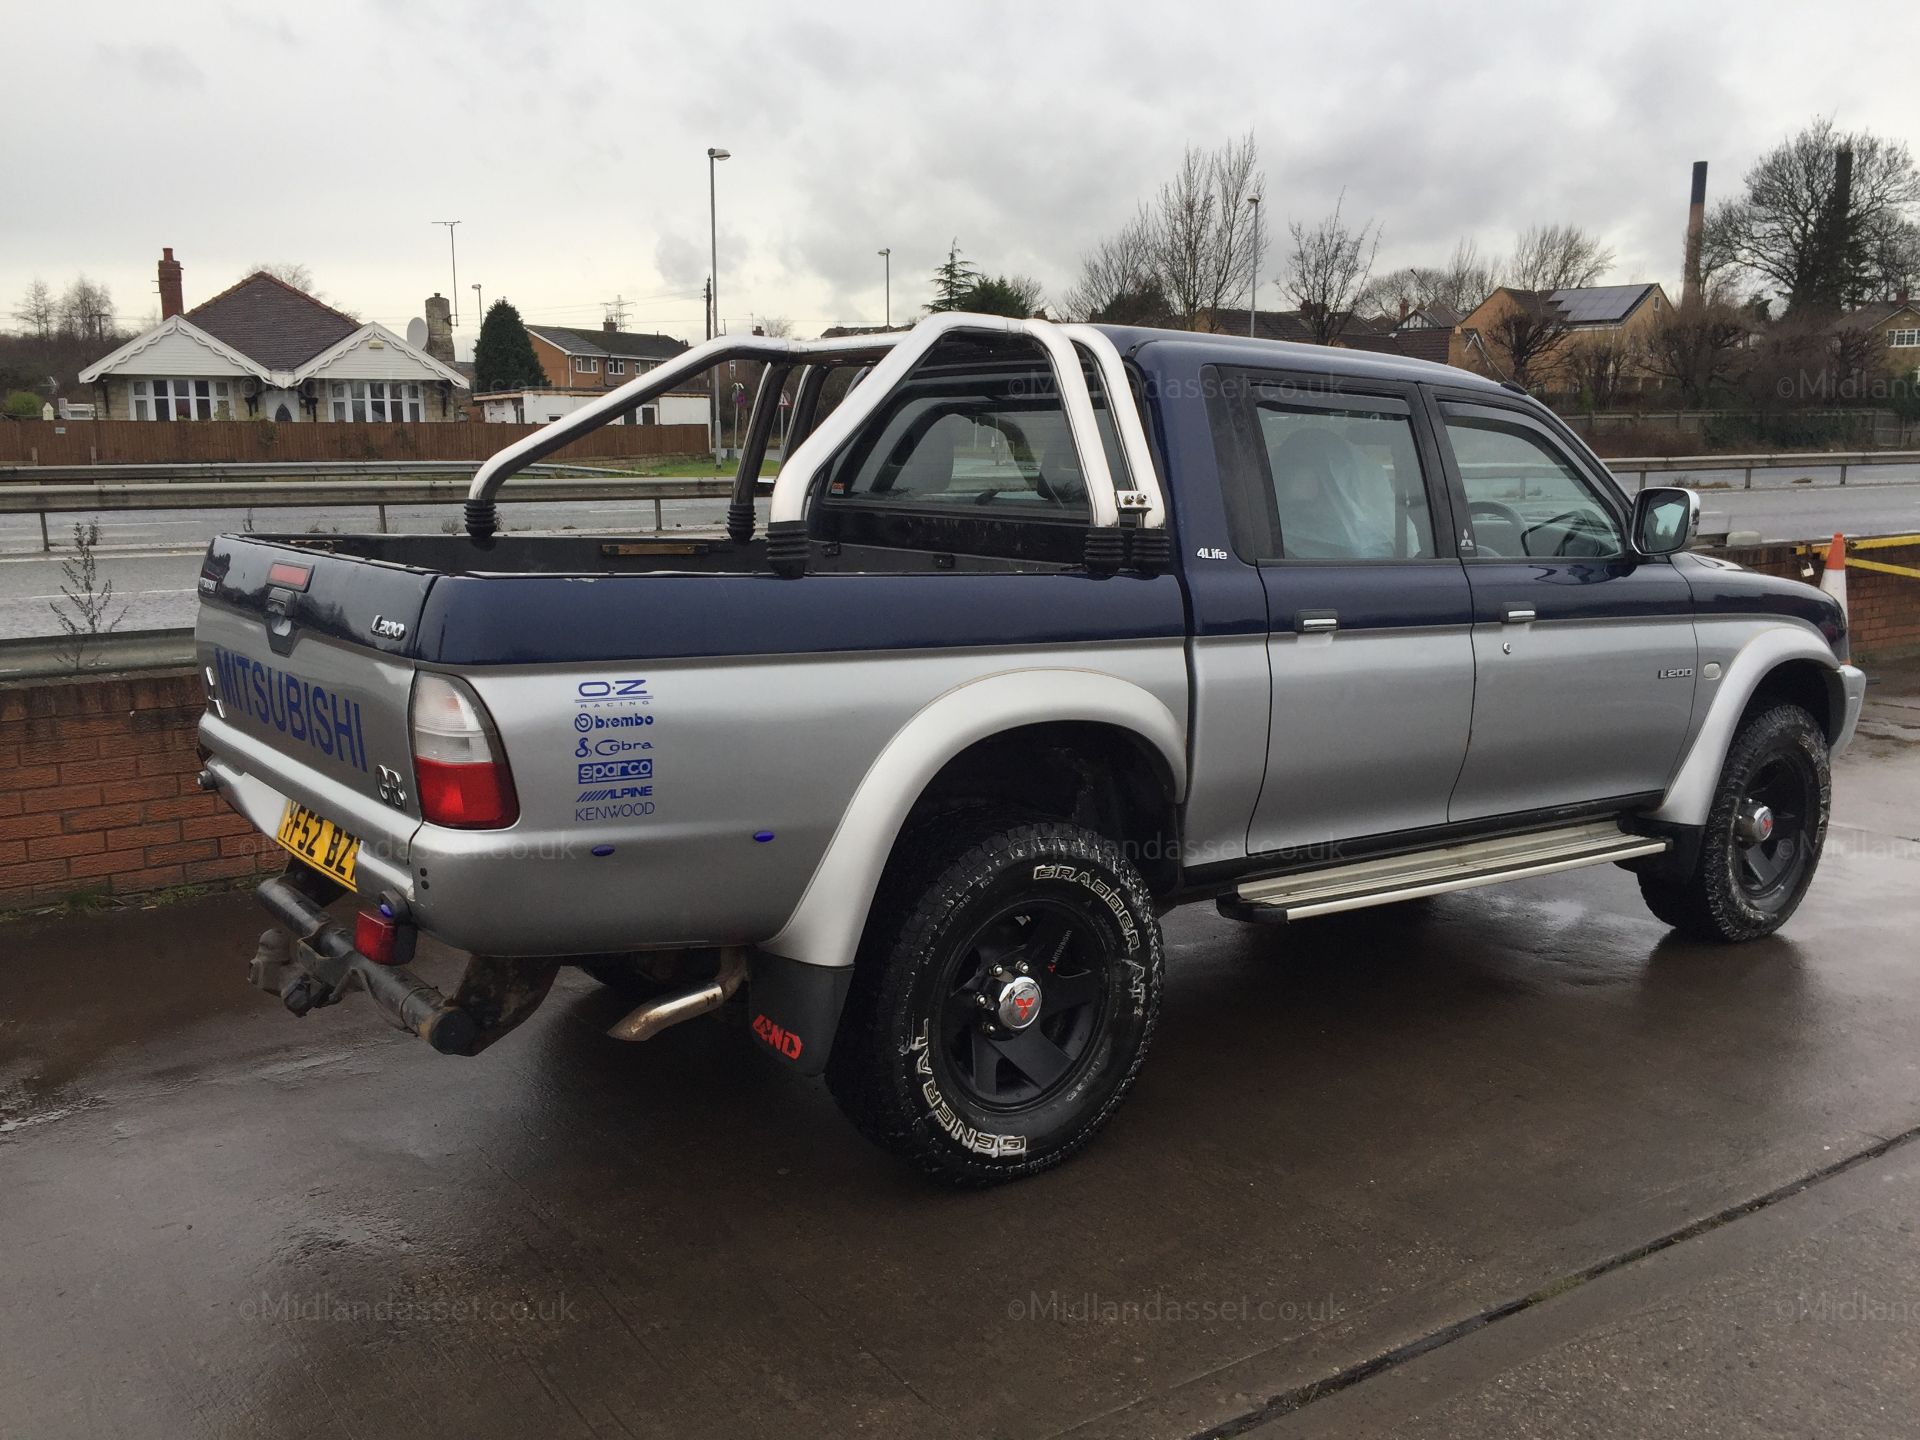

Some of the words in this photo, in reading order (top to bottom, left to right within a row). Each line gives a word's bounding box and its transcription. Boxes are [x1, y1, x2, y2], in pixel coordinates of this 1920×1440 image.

[1196, 547, 1228, 560] 4Life
[371, 614, 405, 637] L200
[1657, 668, 1693, 679] L200
[215, 648, 368, 773] MITSUBISHI
[580, 700, 650, 709] RACING
[595, 713, 654, 728] brembo
[594, 739, 655, 756] Cobra
[579, 760, 652, 782] sparco
[601, 786, 653, 800] ALPINE
[575, 802, 655, 821] KENWOOD
[1033, 862, 1140, 957] GRABBER
[912, 1018, 1027, 1154] GENERAL
